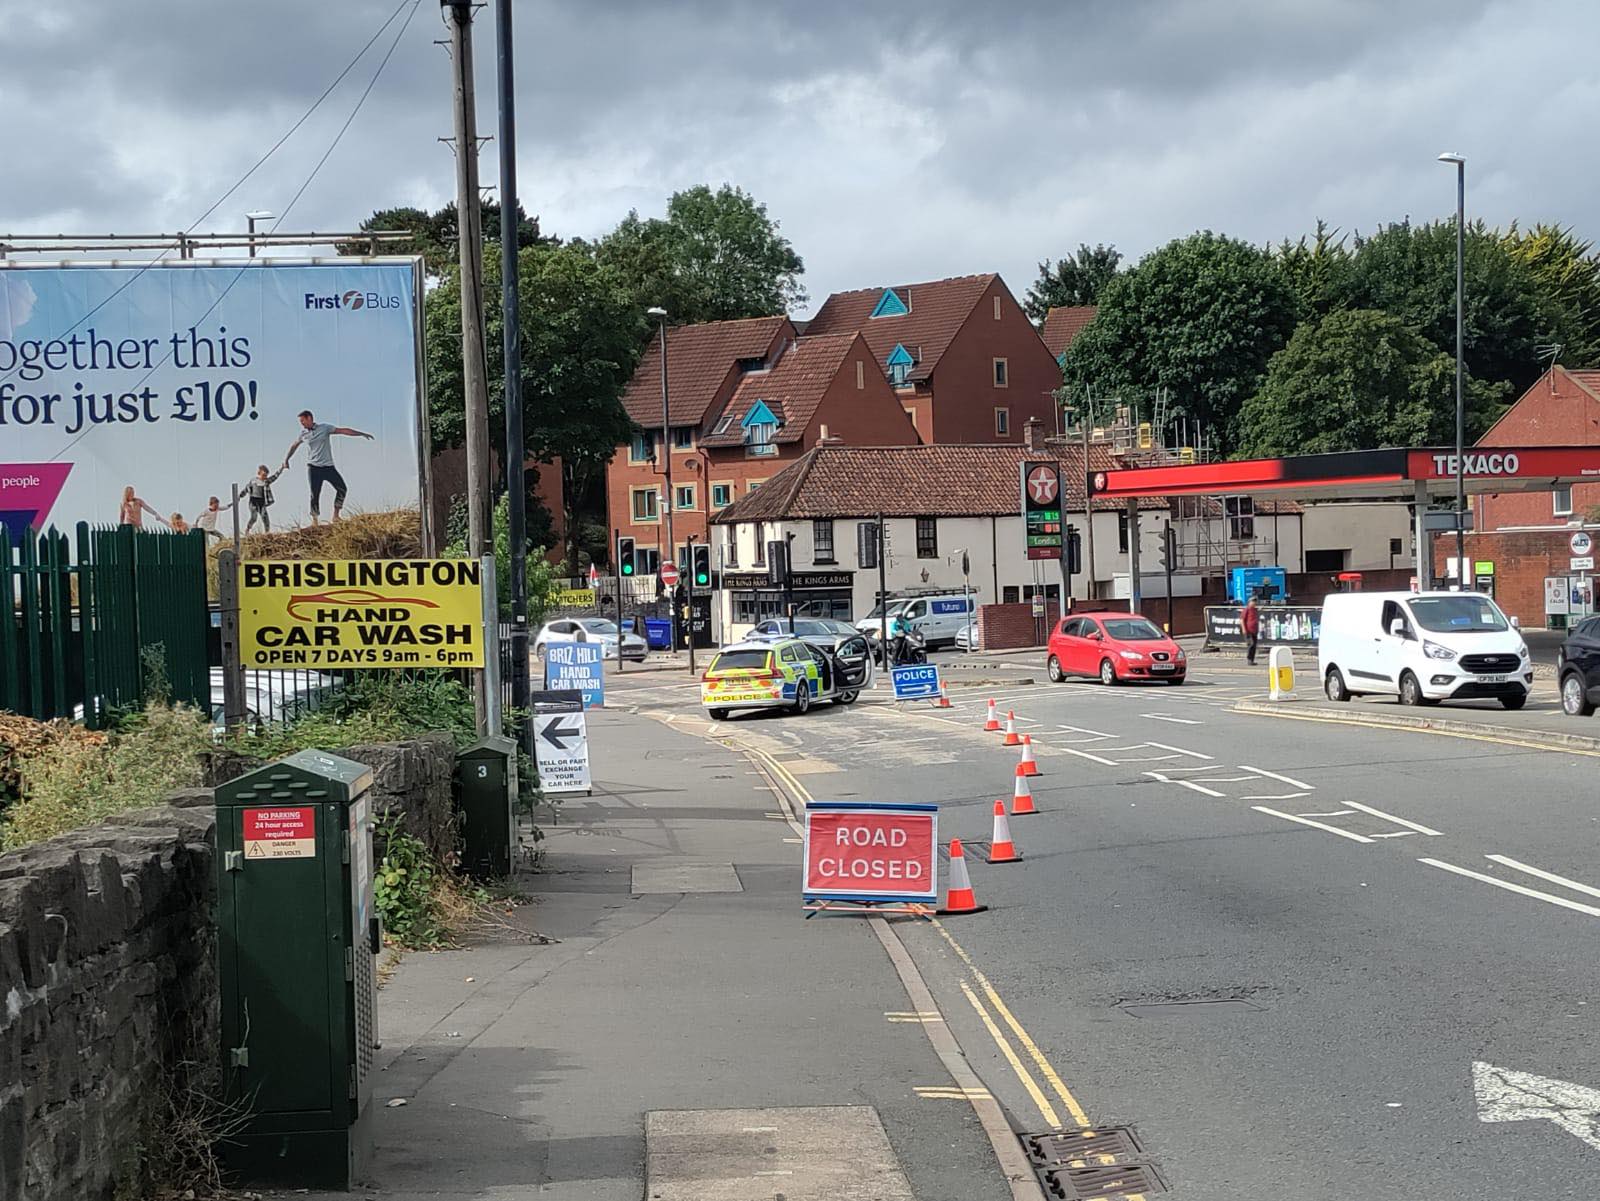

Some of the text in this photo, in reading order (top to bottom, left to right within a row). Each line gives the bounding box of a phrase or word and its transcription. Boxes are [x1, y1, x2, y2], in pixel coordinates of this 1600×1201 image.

[305, 292, 400, 310] First Bus
[171, 327, 251, 368] this
[0, 380, 258, 434] for just £10!
[1433, 453, 1519, 475] TEXACO
[2, 475, 40, 489] people
[244, 561, 480, 587] BRISLINGTON
[804, 576, 827, 585] KINGS
[828, 575, 850, 584] ARMS
[316, 608, 411, 622] HAND
[256, 624, 472, 647] CAR WASH
[255, 650, 306, 664] OPEN
[312, 650, 321, 663] 7
[327, 649, 377, 663] DAYS
[383, 649, 420, 663] 9am
[436, 648, 474, 665] 6pm
[550, 646, 599, 665] BRIZ HILL
[560, 666, 590, 679] HAND
[895, 669, 935, 682] POLICE
[551, 678, 600, 689] CAR WASH
[713, 693, 762, 702] POLICE
[478, 766, 487, 778] 3
[836, 827, 907, 847] ROAD
[818, 858, 922, 879] CLOSED
